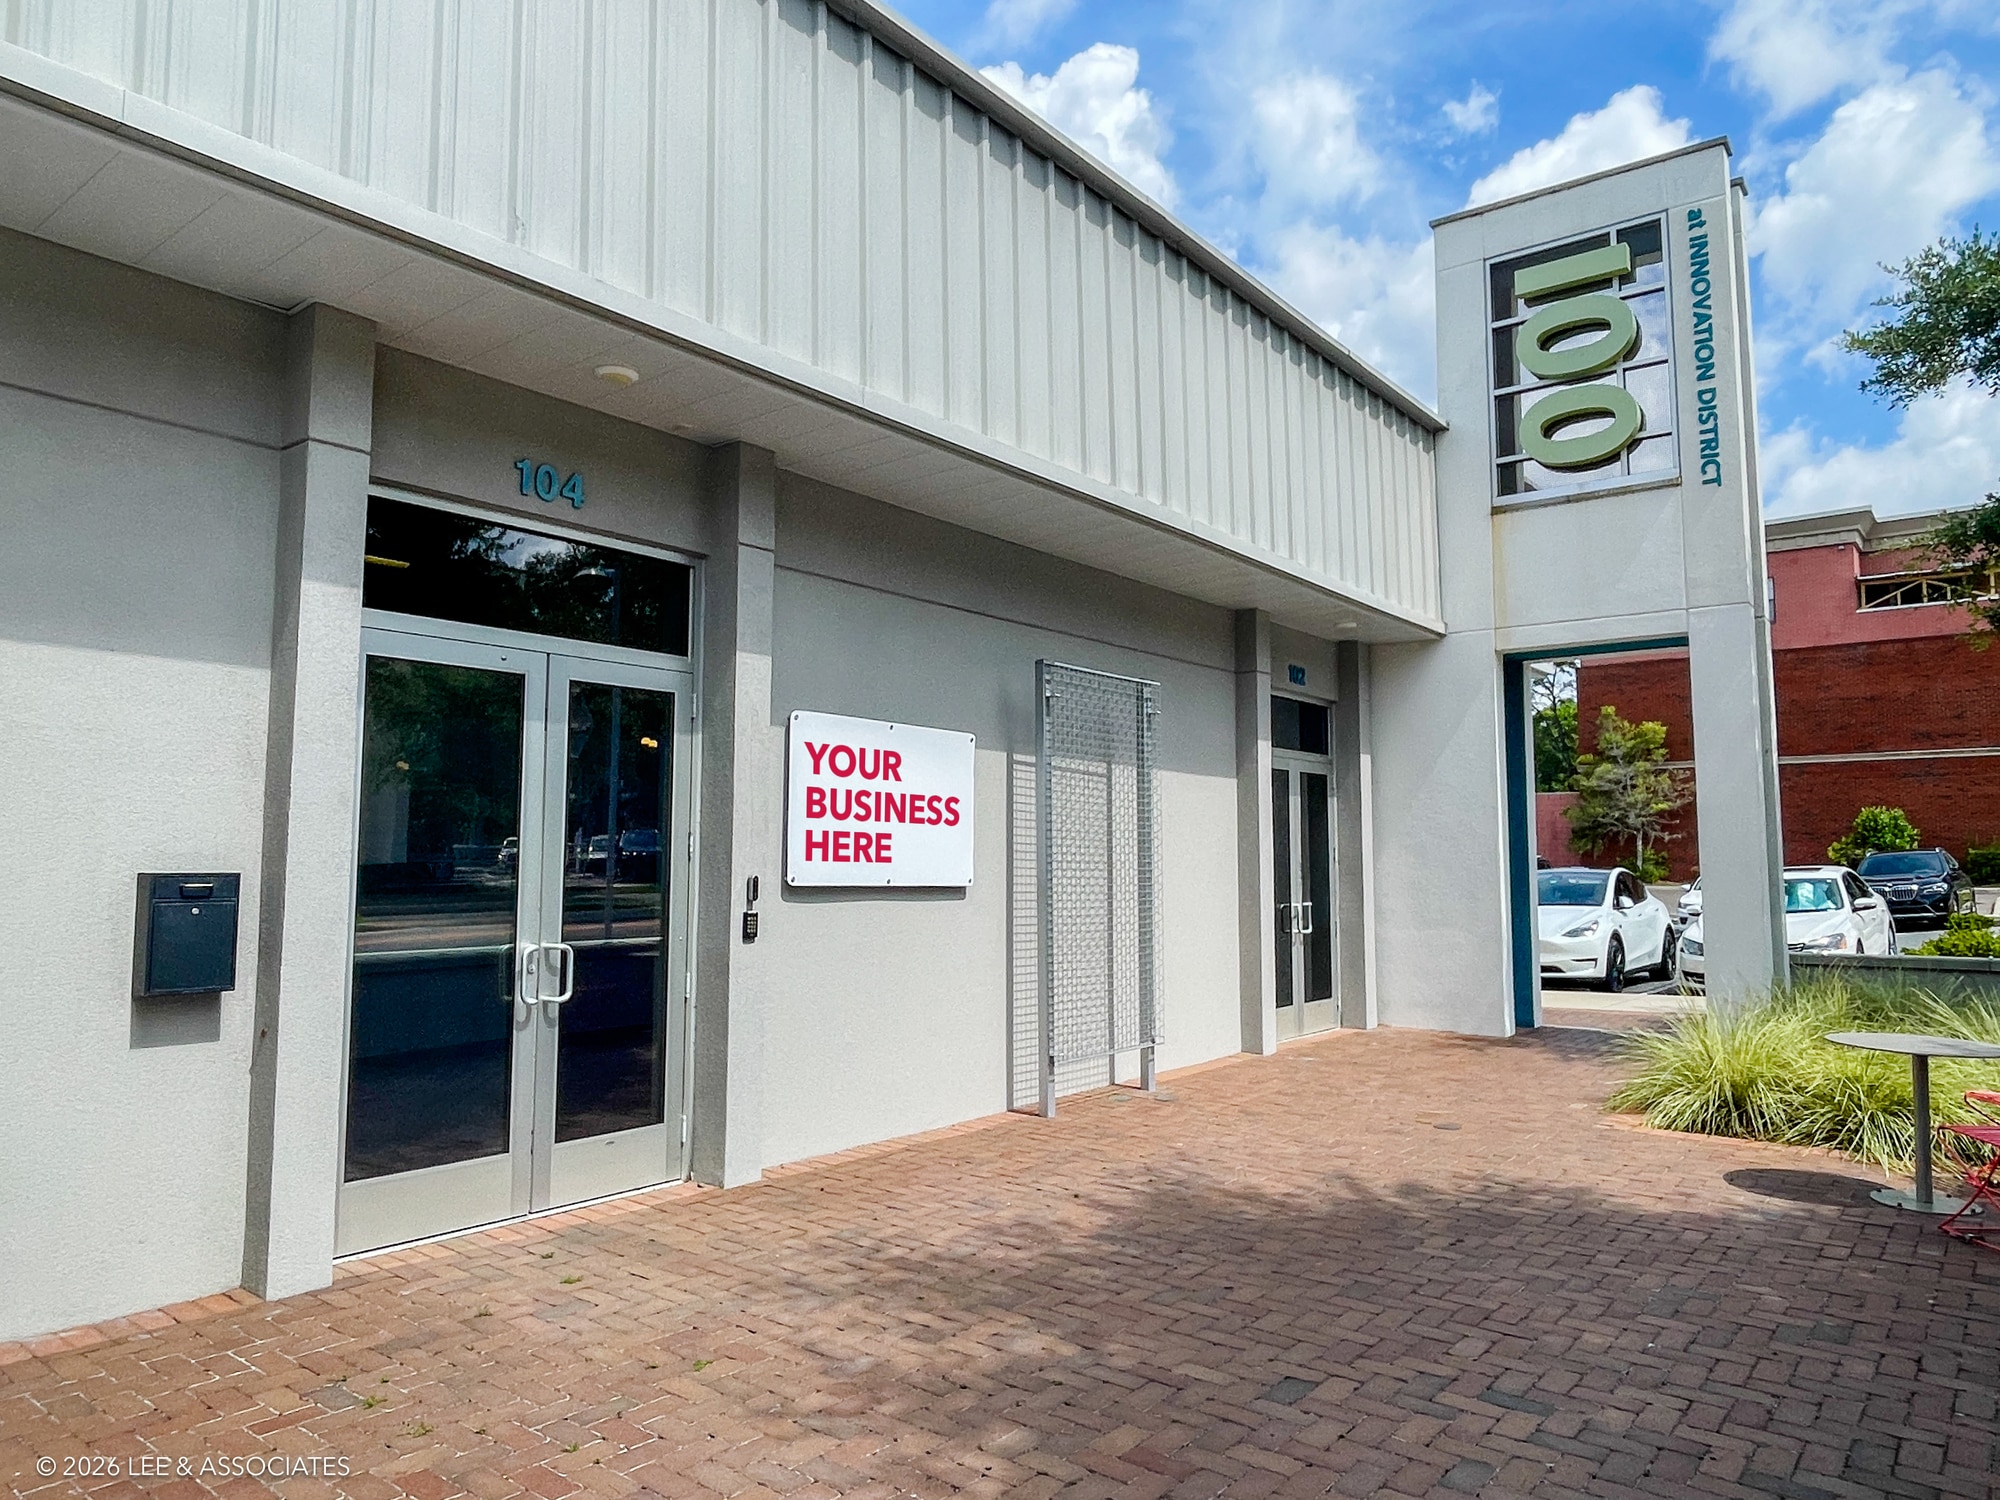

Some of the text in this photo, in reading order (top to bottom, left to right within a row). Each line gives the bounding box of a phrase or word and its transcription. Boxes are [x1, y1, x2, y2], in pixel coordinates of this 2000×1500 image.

[1514, 241, 1642, 468] 100
[1687, 207, 1722, 487] at INNOVATION DISTRICT
[514, 458, 585, 509] 104
[804, 741, 902, 782] YOUR
[806, 786, 961, 827] BUSINESS
[805, 829, 892, 864] HERE
